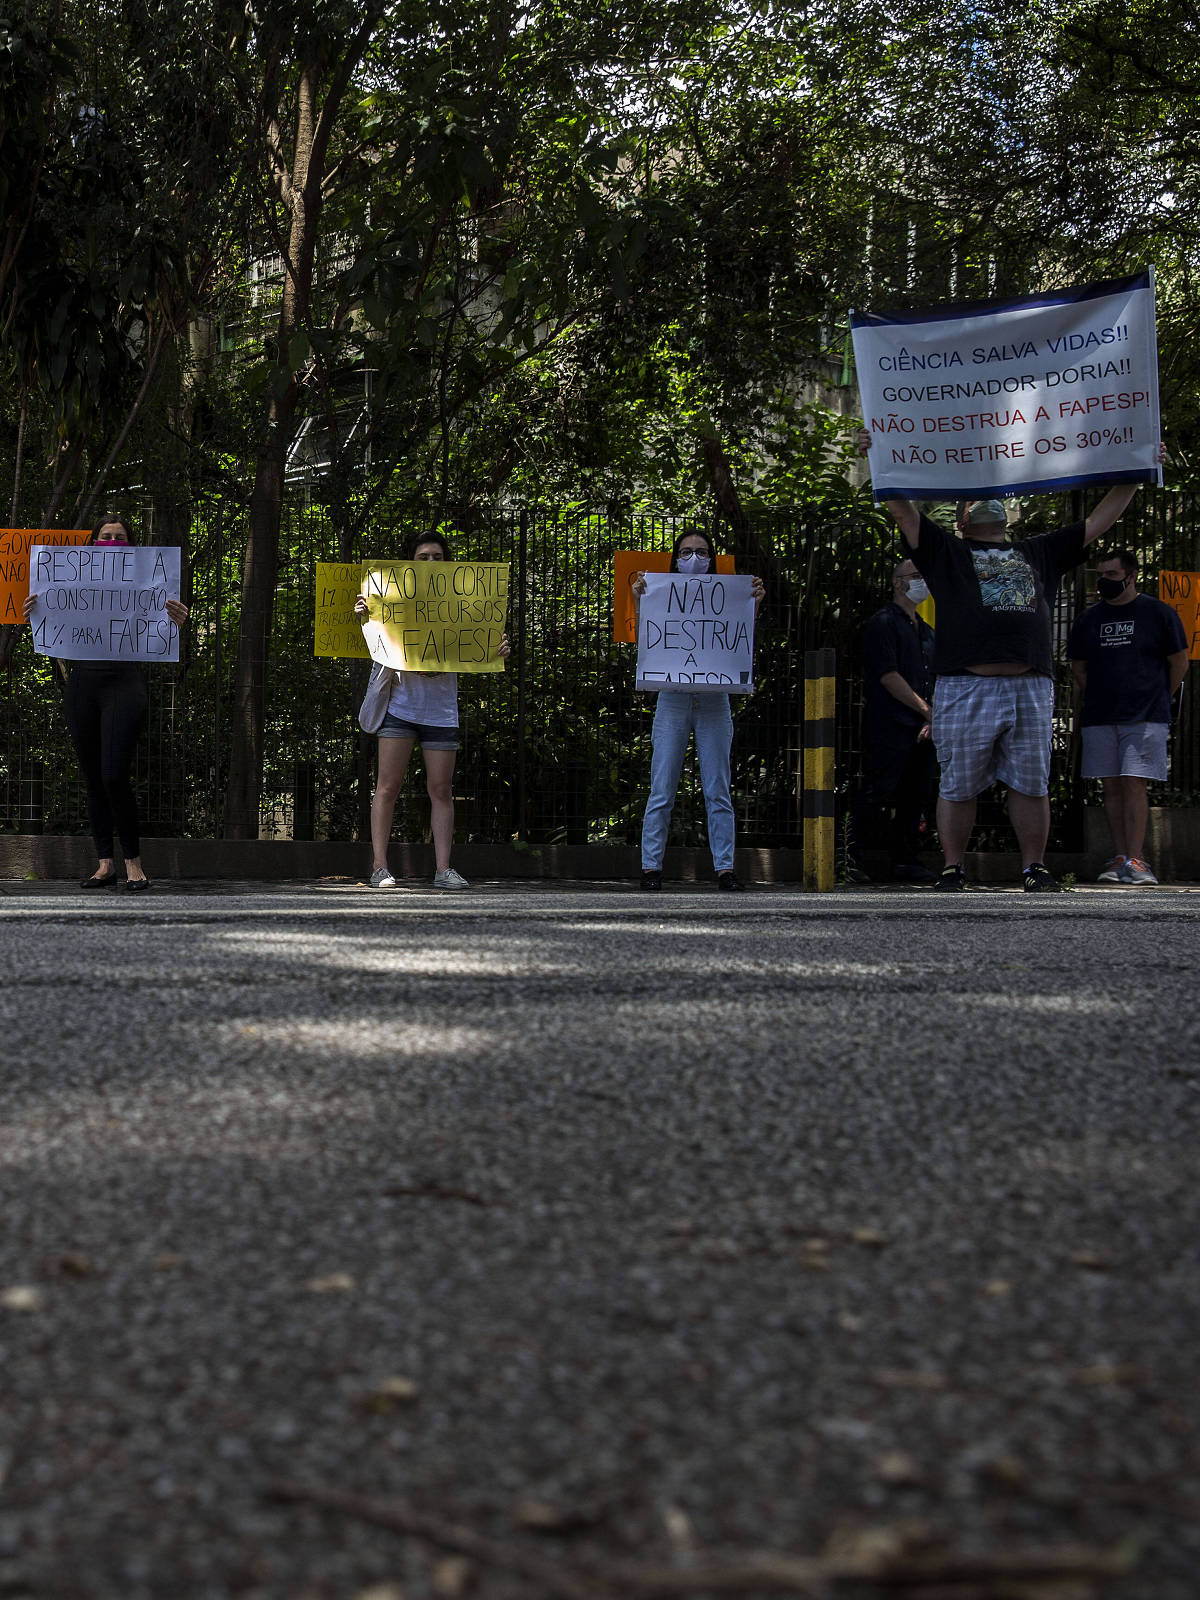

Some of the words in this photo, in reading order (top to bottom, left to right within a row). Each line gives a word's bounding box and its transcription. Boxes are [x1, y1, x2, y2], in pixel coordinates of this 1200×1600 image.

[878, 347, 963, 371] CIÊNCIA
[972, 342, 1038, 364] SALVA
[1047, 325, 1128, 353] VIDAS!!
[883, 375, 1036, 402] GOVERNADOR
[1045, 358, 1131, 388] DORIA!!
[871, 413, 915, 433] NÃO
[923, 409, 1026, 433] DESTRUA
[1034, 406, 1050, 422] A
[1059, 391, 1150, 418] FAPESP!
[892, 445, 937, 464] NÃO
[945, 441, 1025, 464] RETIRE
[1034, 436, 1067, 454] OS
[1076, 426, 1134, 449] 30%!!
[37, 550, 134, 582] RESPEITE
[152, 552, 167, 583] A
[427, 573, 447, 598] AO
[452, 566, 508, 597] CORTE
[5, 592, 17, 618] A
[382, 602, 406, 624] DE
[416, 600, 504, 623] RECURSOS
[667, 576, 725, 615] NÃO
[34, 616, 66, 649] 1%
[72, 627, 103, 645] PARA
[109, 618, 178, 655] FAPESP
[403, 628, 501, 663] FAPESP
[646, 619, 750, 654] DESTRUA
[1104, 625, 1113, 634] O
[1118, 624, 1132, 633] Mg
[684, 653, 698, 667] A
